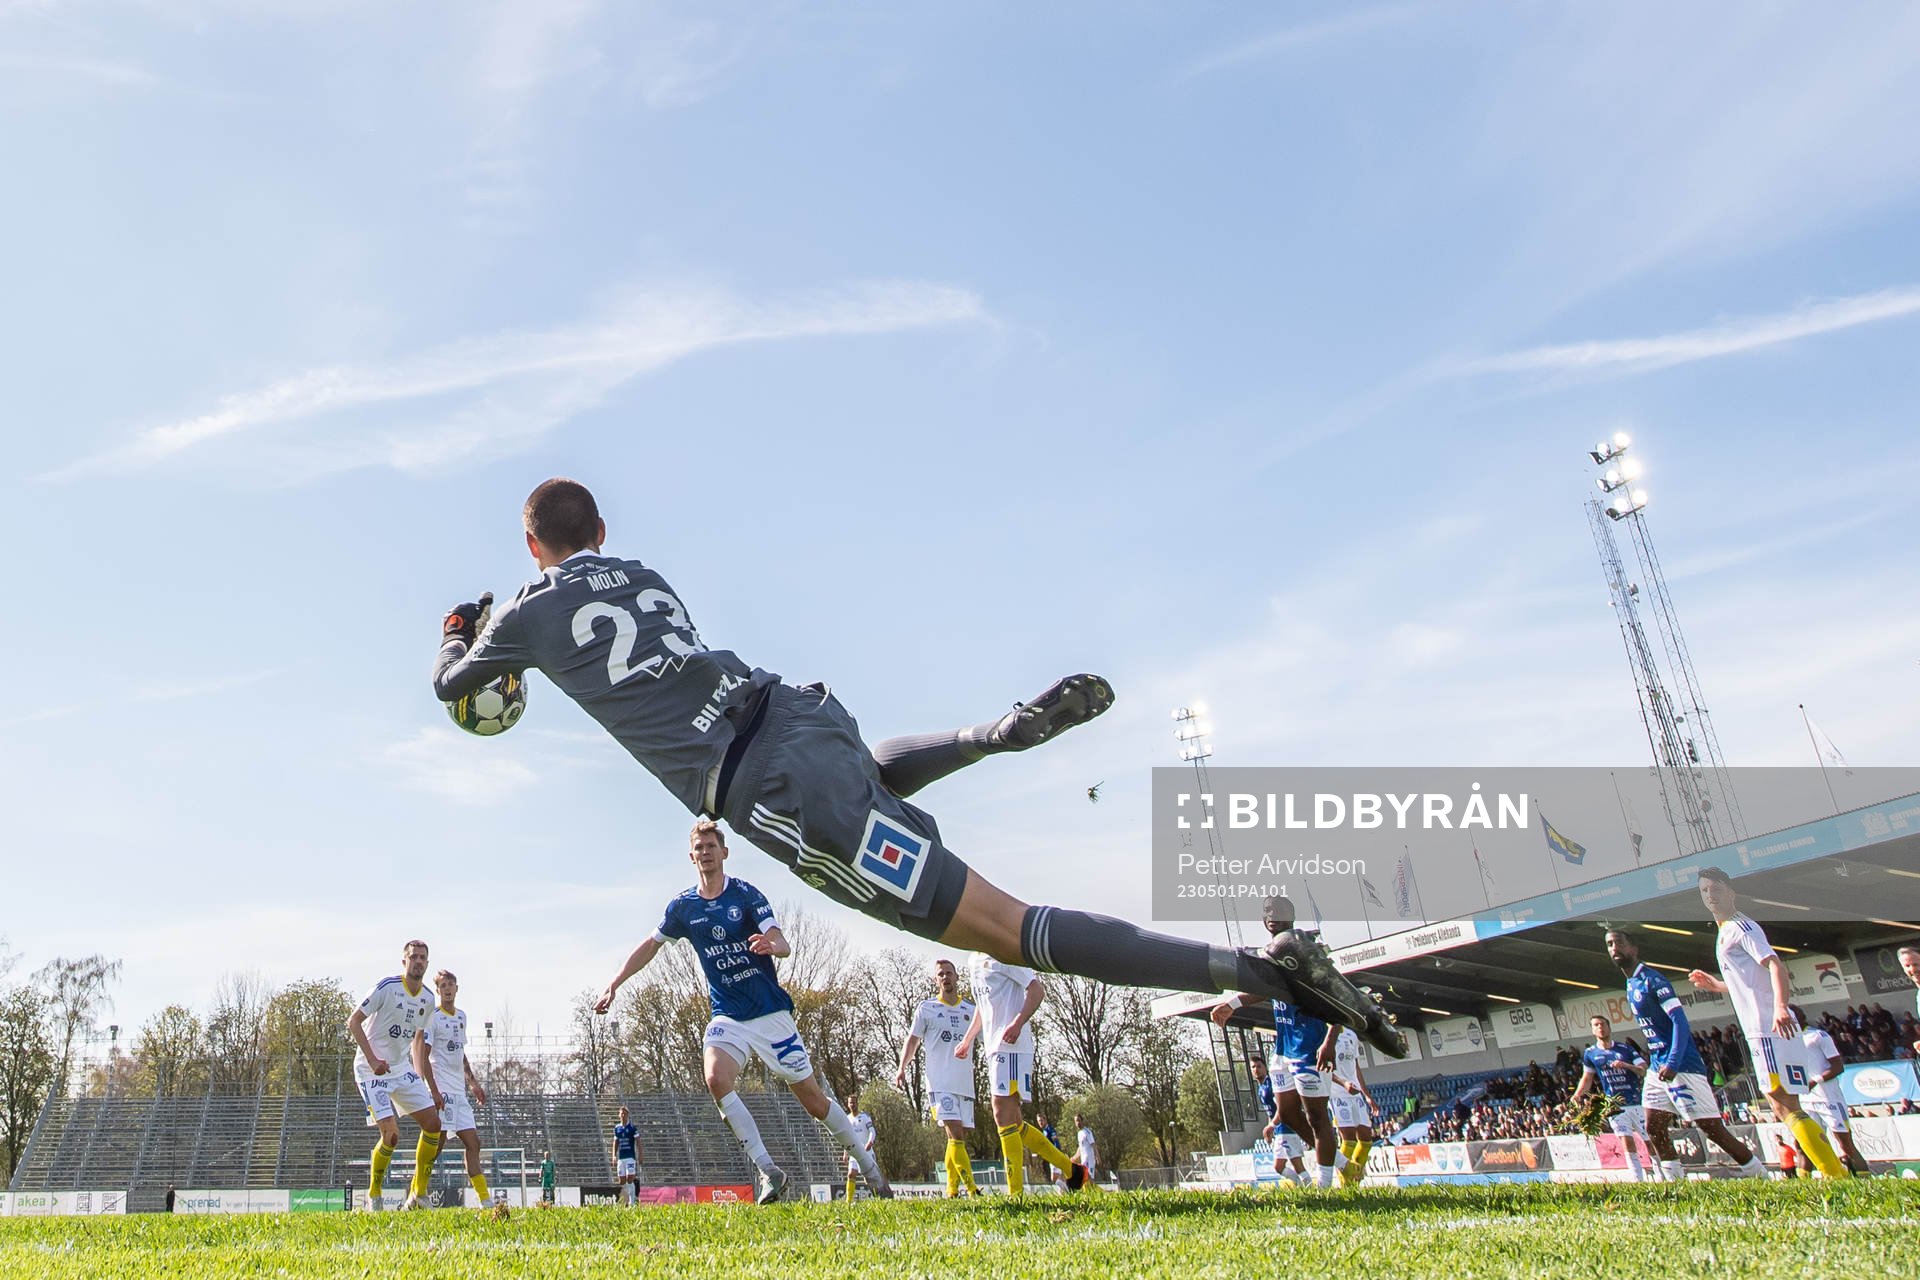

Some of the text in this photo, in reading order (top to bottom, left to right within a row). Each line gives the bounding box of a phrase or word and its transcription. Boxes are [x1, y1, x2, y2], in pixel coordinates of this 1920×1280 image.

[586, 570, 630, 592] MOLIN
[571, 588, 709, 686] 23
[1509, 1006, 1534, 1025] GR8
[1483, 1148, 1521, 1165] Swedbank
